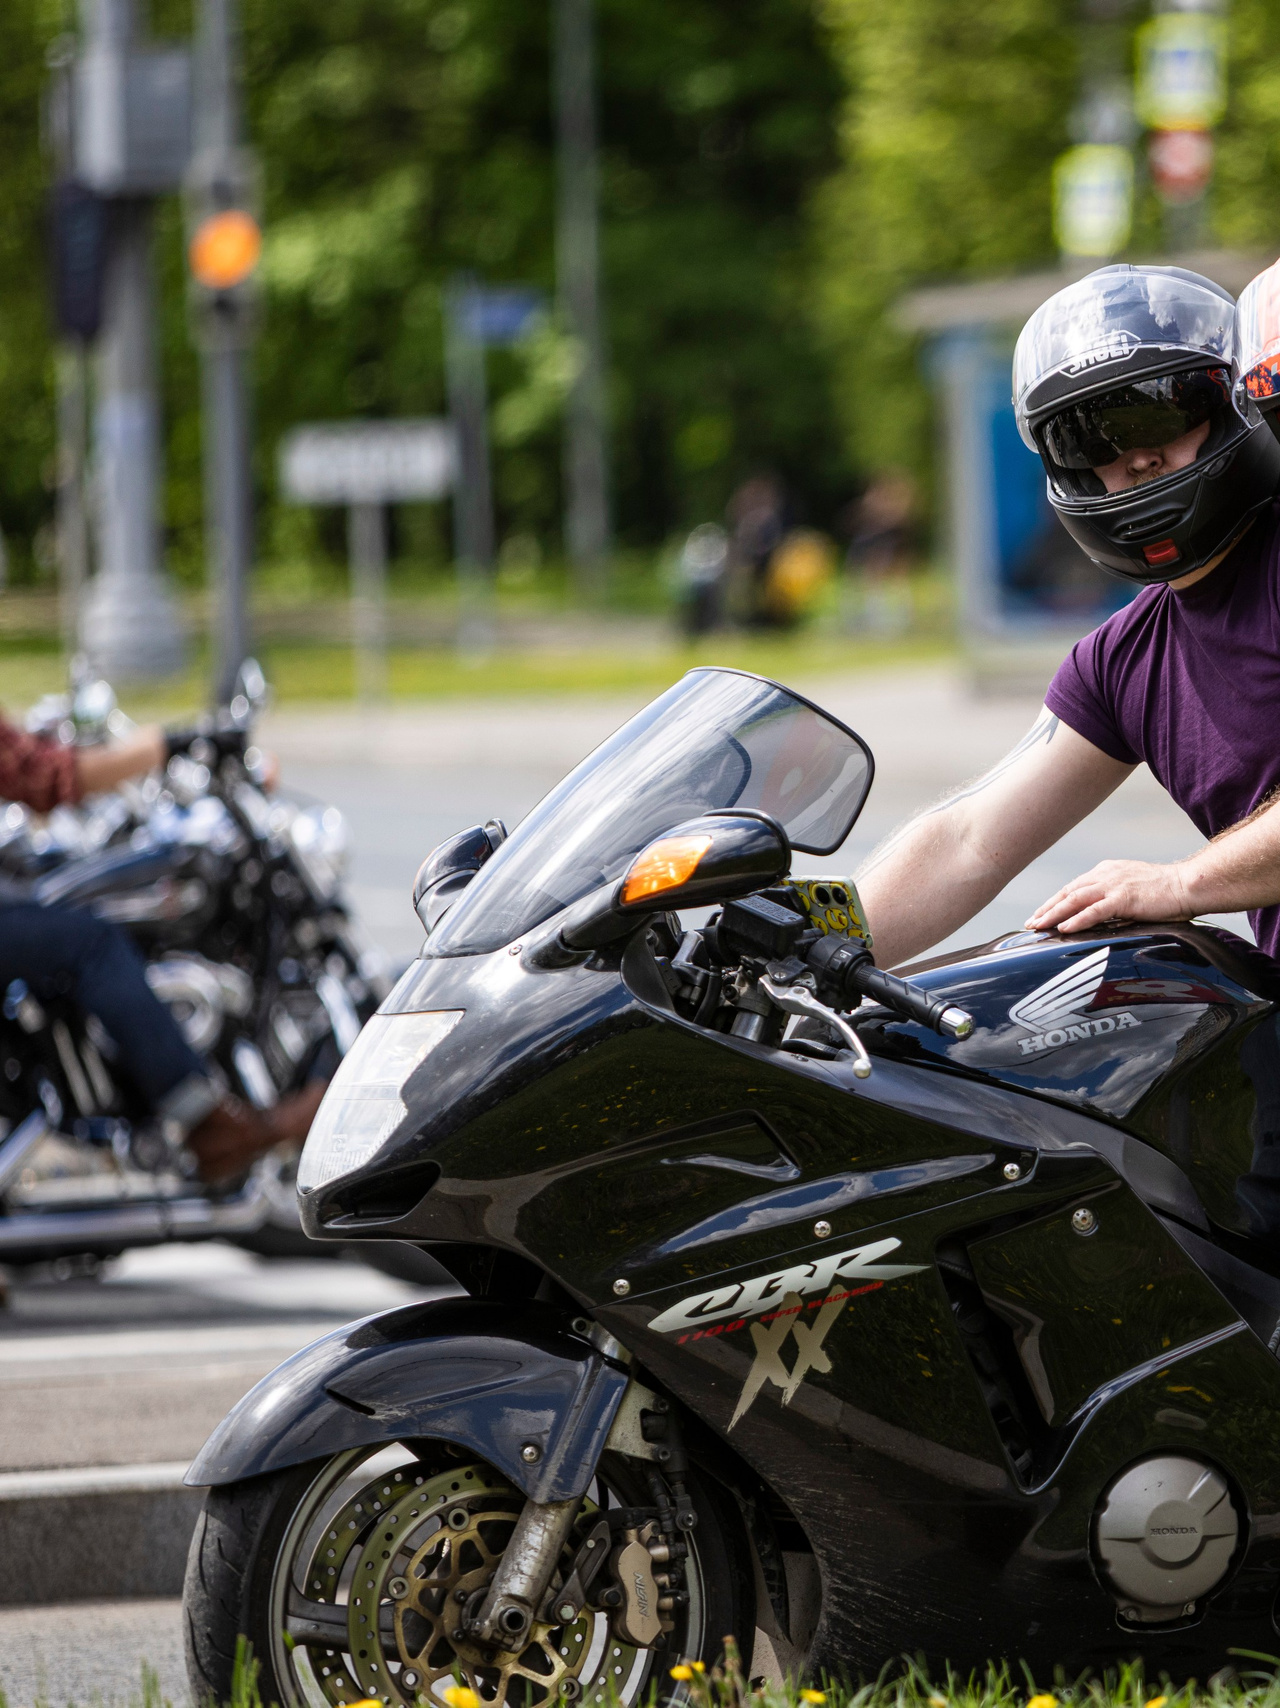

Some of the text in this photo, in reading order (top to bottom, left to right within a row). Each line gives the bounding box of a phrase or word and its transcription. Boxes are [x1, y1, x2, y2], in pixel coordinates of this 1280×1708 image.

[1068, 333, 1130, 374] SHOEI
[1017, 1011, 1142, 1055] HONDA
[647, 1237, 932, 1333] CBR
[677, 1319, 746, 1345] 1100
[760, 1305, 803, 1323] SUPER
[727, 1284, 848, 1433] XX
[1150, 1526, 1198, 1536] HONDA
